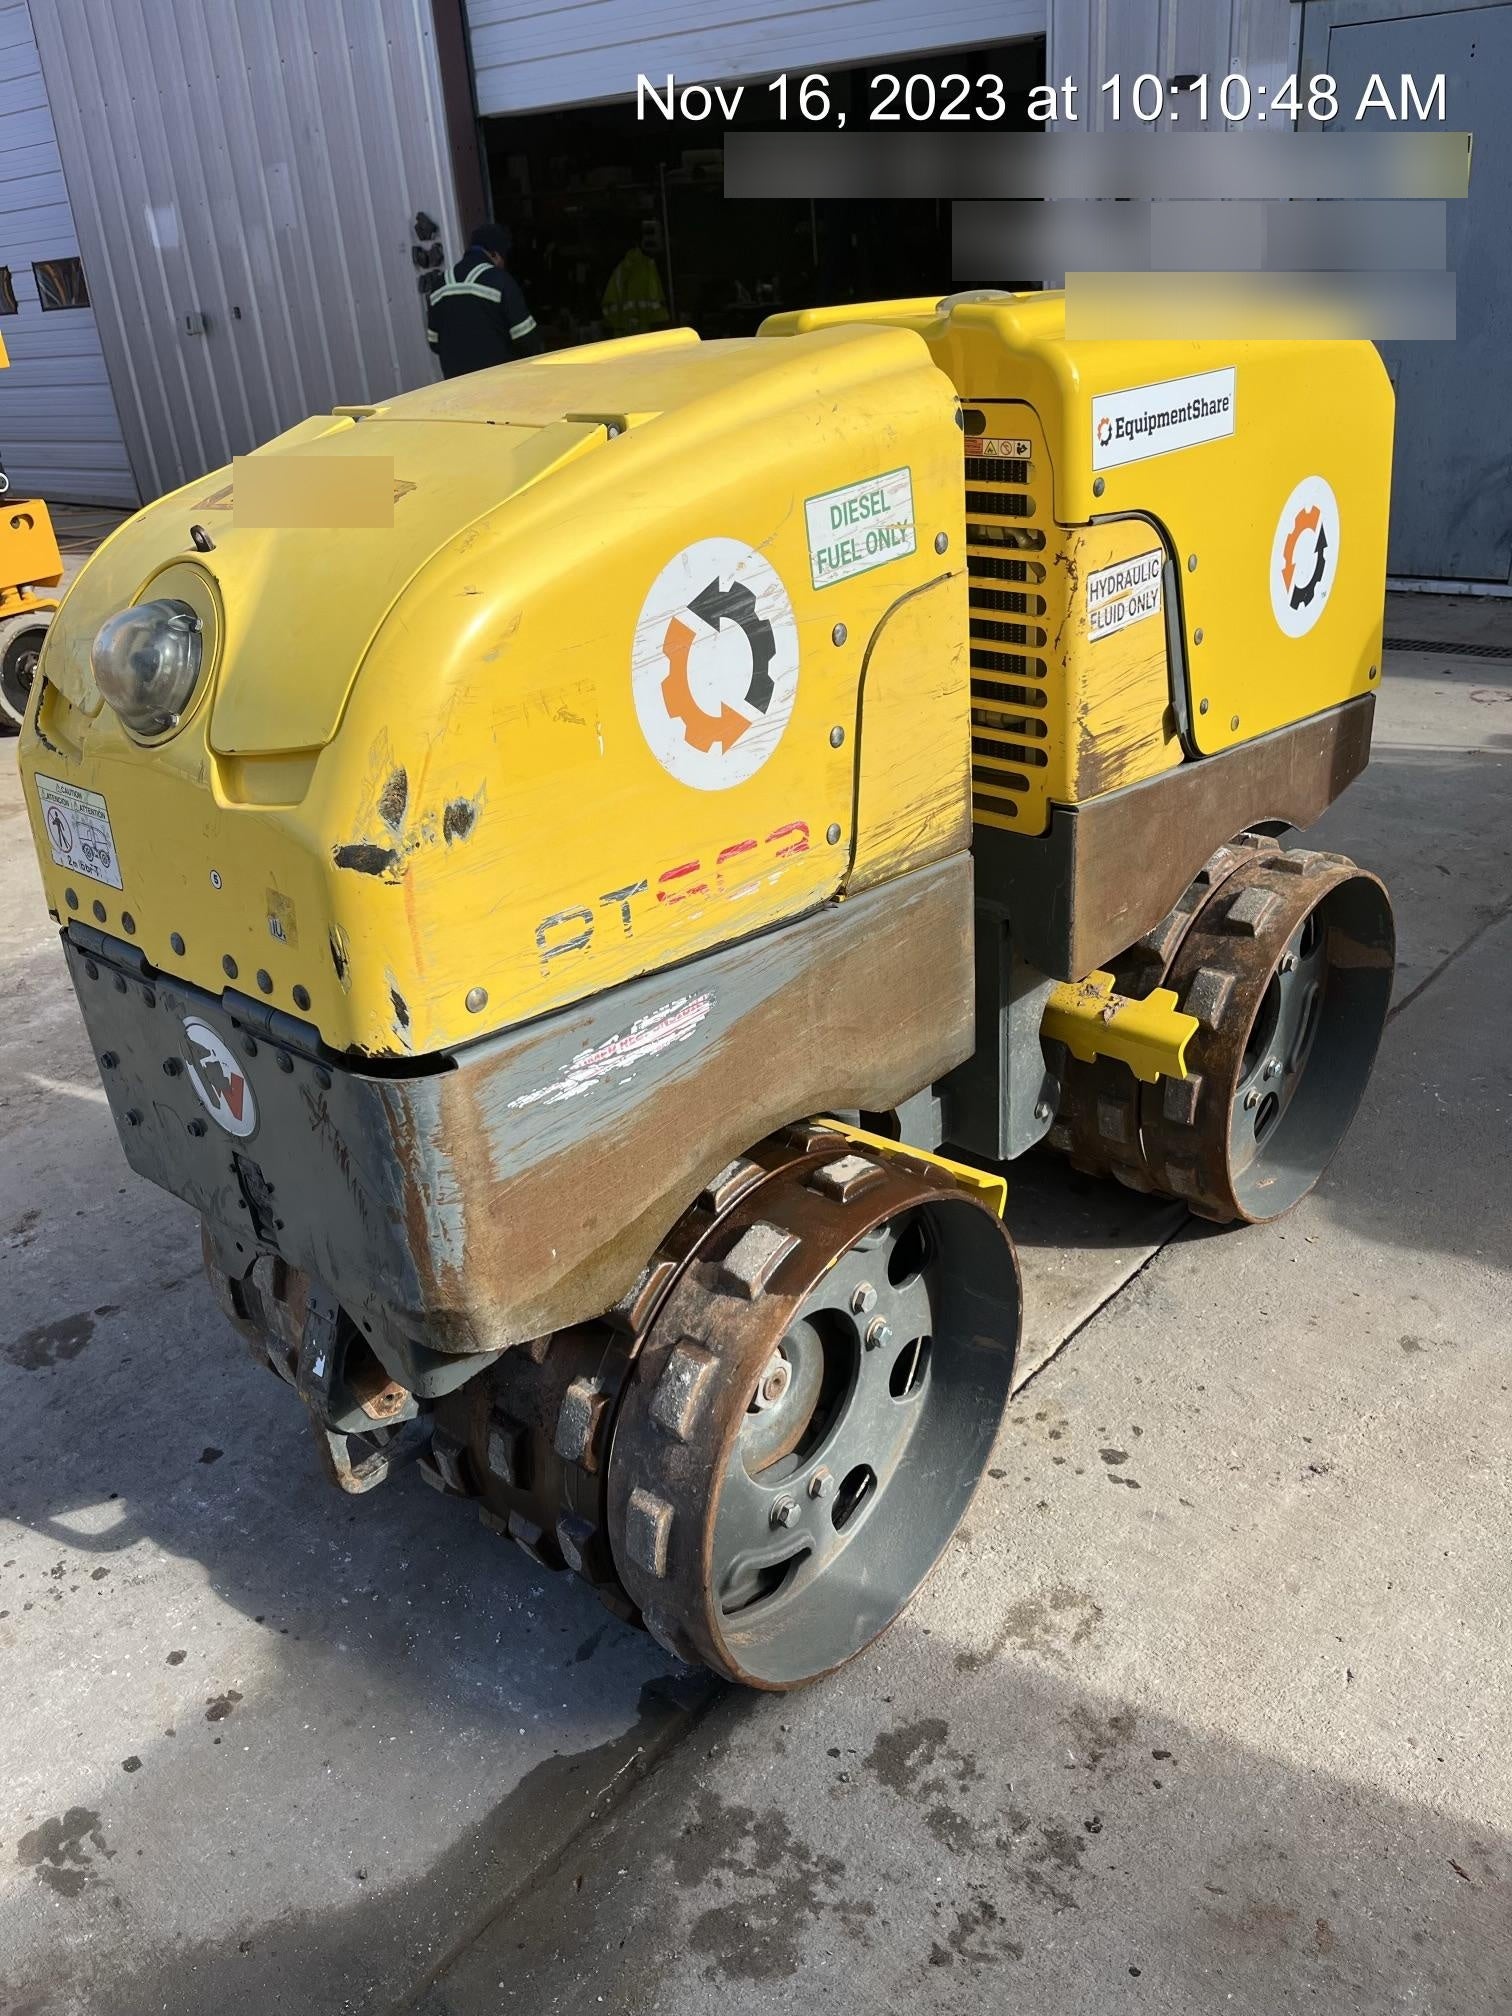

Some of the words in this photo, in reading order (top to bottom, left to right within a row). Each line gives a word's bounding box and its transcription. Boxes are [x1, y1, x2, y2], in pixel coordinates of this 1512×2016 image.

[1115, 396, 1229, 441] EquipmentShare
[830, 489, 891, 531] DIESEL
[816, 538, 863, 574] FUEL
[865, 518, 908, 555] ONLY
[1090, 559, 1160, 602] HYDRAULIC
[1090, 602, 1125, 629] FLUID
[1128, 587, 1159, 617] ONLY
[61, 784, 83, 800] CAUTION
[79, 804, 106, 820] ATTENTION
